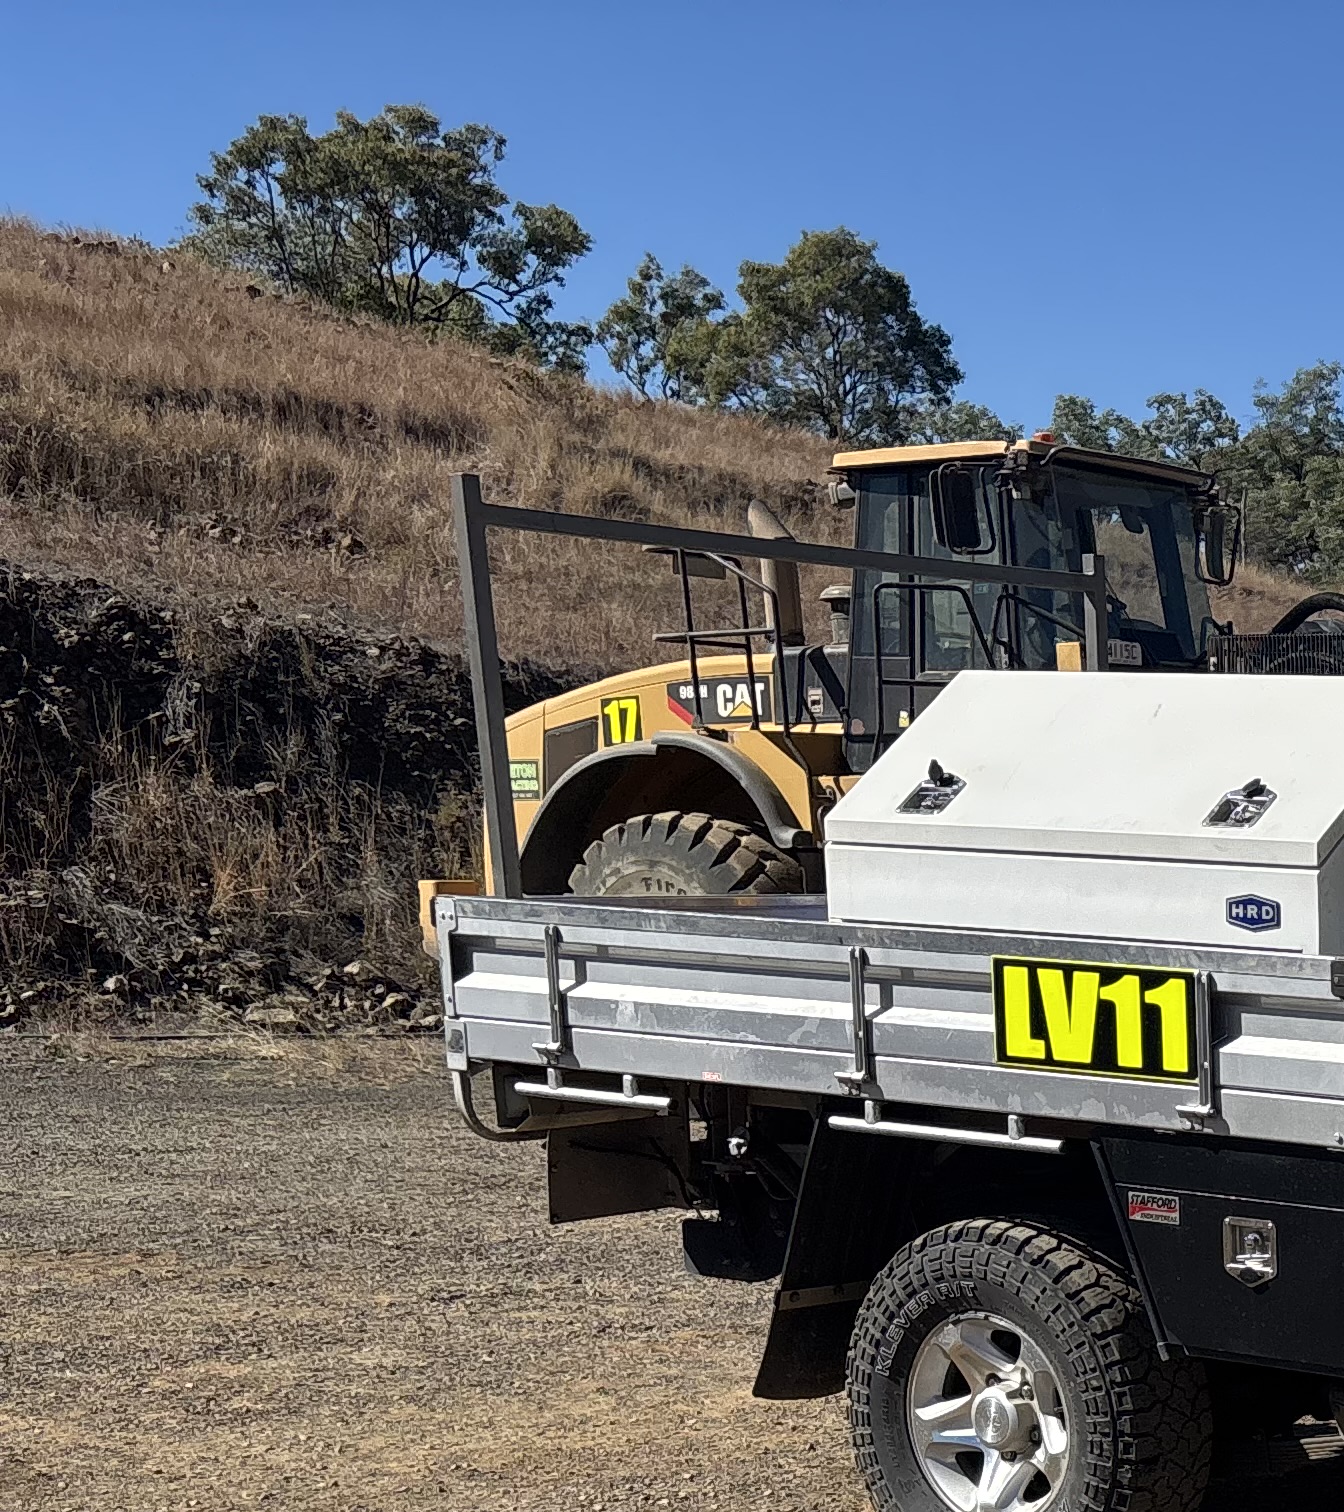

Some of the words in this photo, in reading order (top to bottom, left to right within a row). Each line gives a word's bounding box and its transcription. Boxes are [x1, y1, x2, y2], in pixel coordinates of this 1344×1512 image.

[678, 684, 708, 699] 98H
[716, 682, 765, 718] CAT
[603, 698, 638, 744] 17
[1002, 965, 1189, 1073] LV11
[1130, 1194, 1178, 1210] STAFFORD
[874, 1290, 936, 1377] KLEVER
[935, 1280, 976, 1299] R/T
